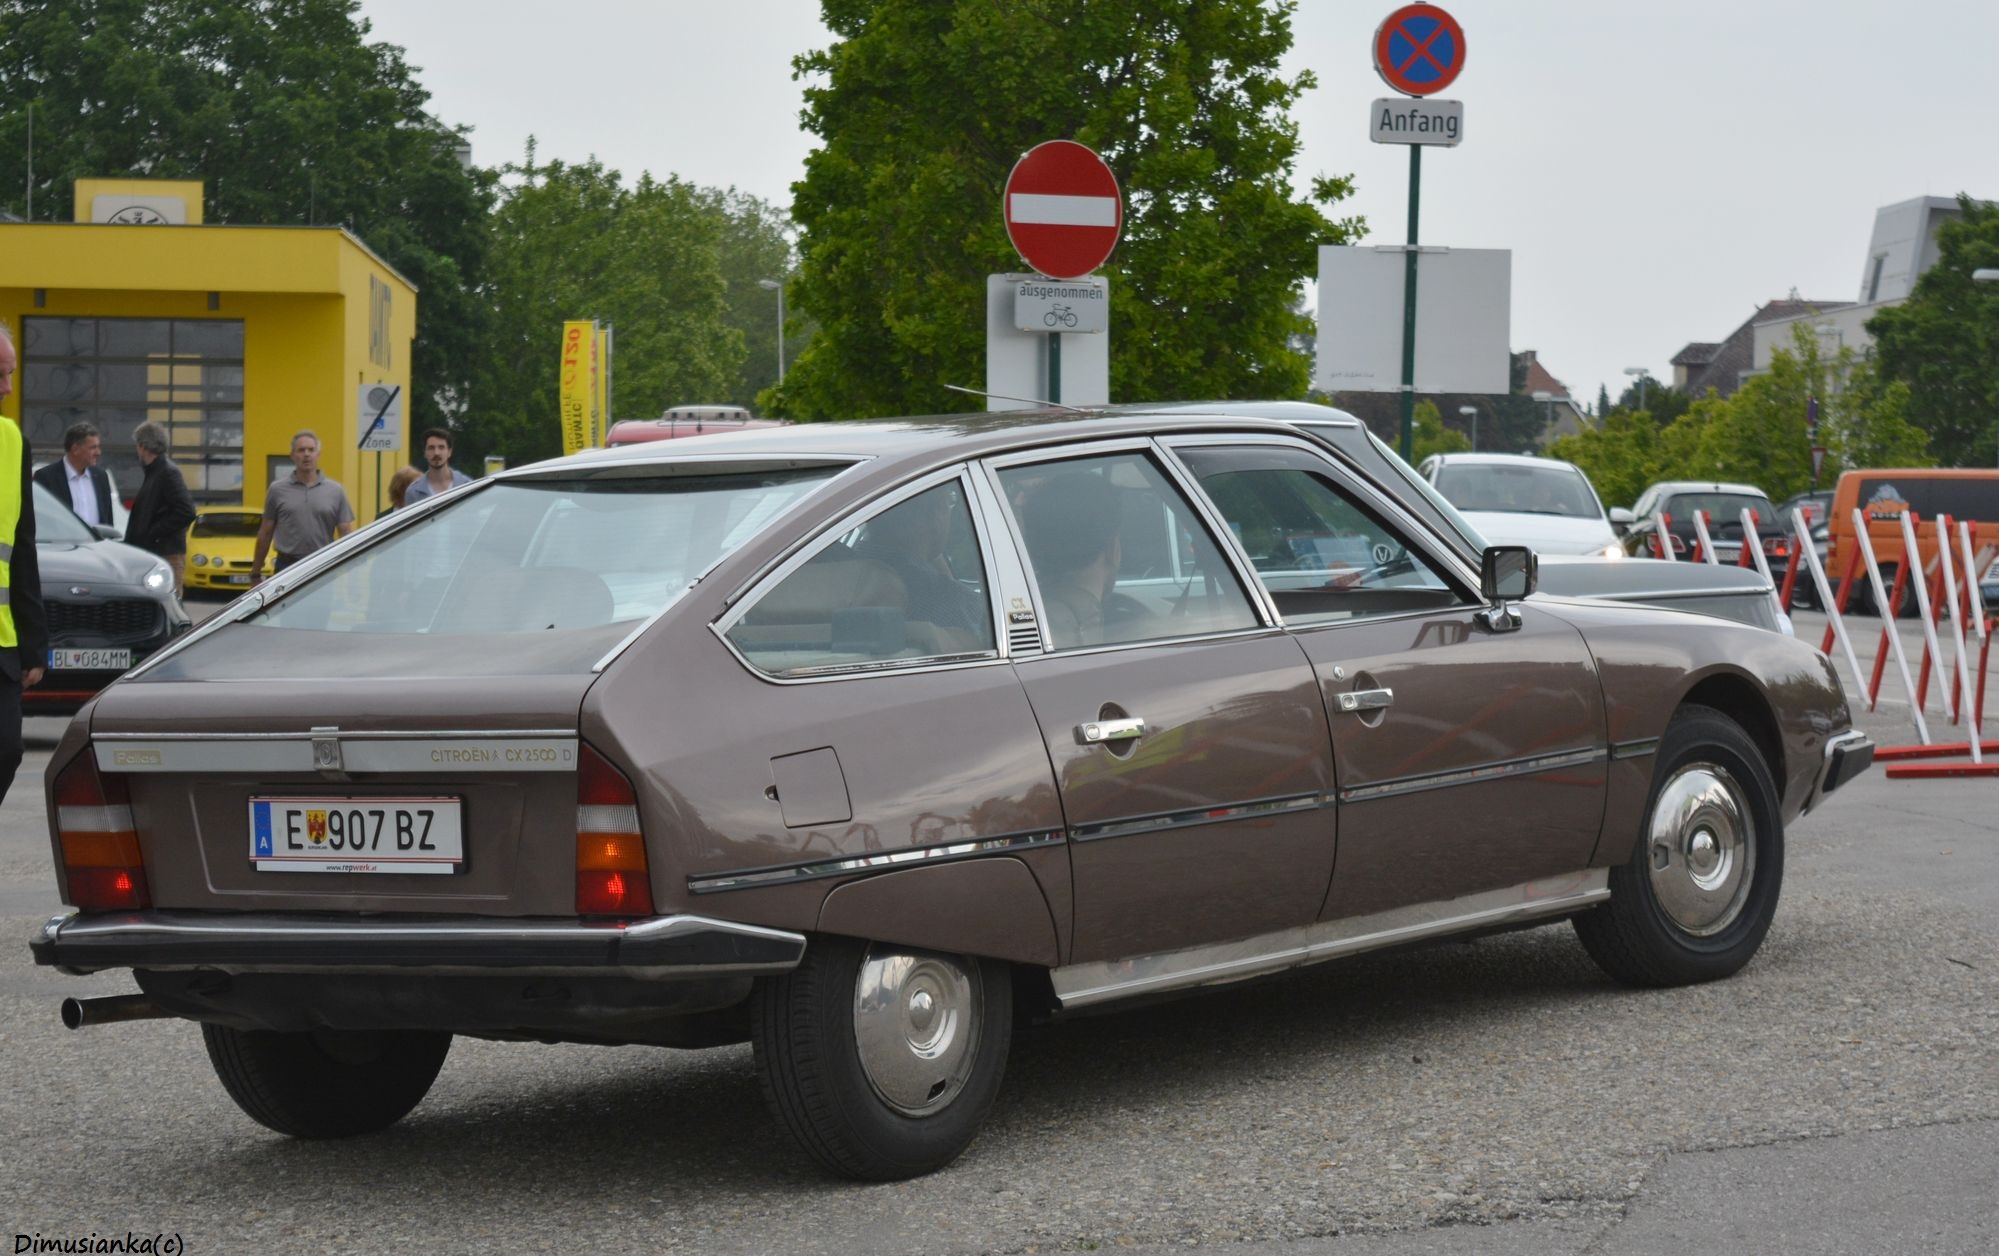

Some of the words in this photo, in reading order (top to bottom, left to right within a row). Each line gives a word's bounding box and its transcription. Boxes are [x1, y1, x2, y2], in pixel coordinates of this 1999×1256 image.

[1379, 108, 1458, 138] Anfang
[1020, 286, 1103, 300] ausgenommen
[366, 437, 392, 449] Zone
[54, 651, 72, 667] BL
[81, 651, 128, 668] 084MM
[431, 747, 490, 762] CITROËN
[505, 749, 523, 761] CX
[526, 748, 557, 761] 2500
[563, 750, 572, 761] D
[286, 810, 304, 850] E
[328, 810, 385, 851] 907
[396, 810, 436, 851] BZ
[260, 836, 269, 848] A
[326, 863, 377, 873] www.repwerk.at
